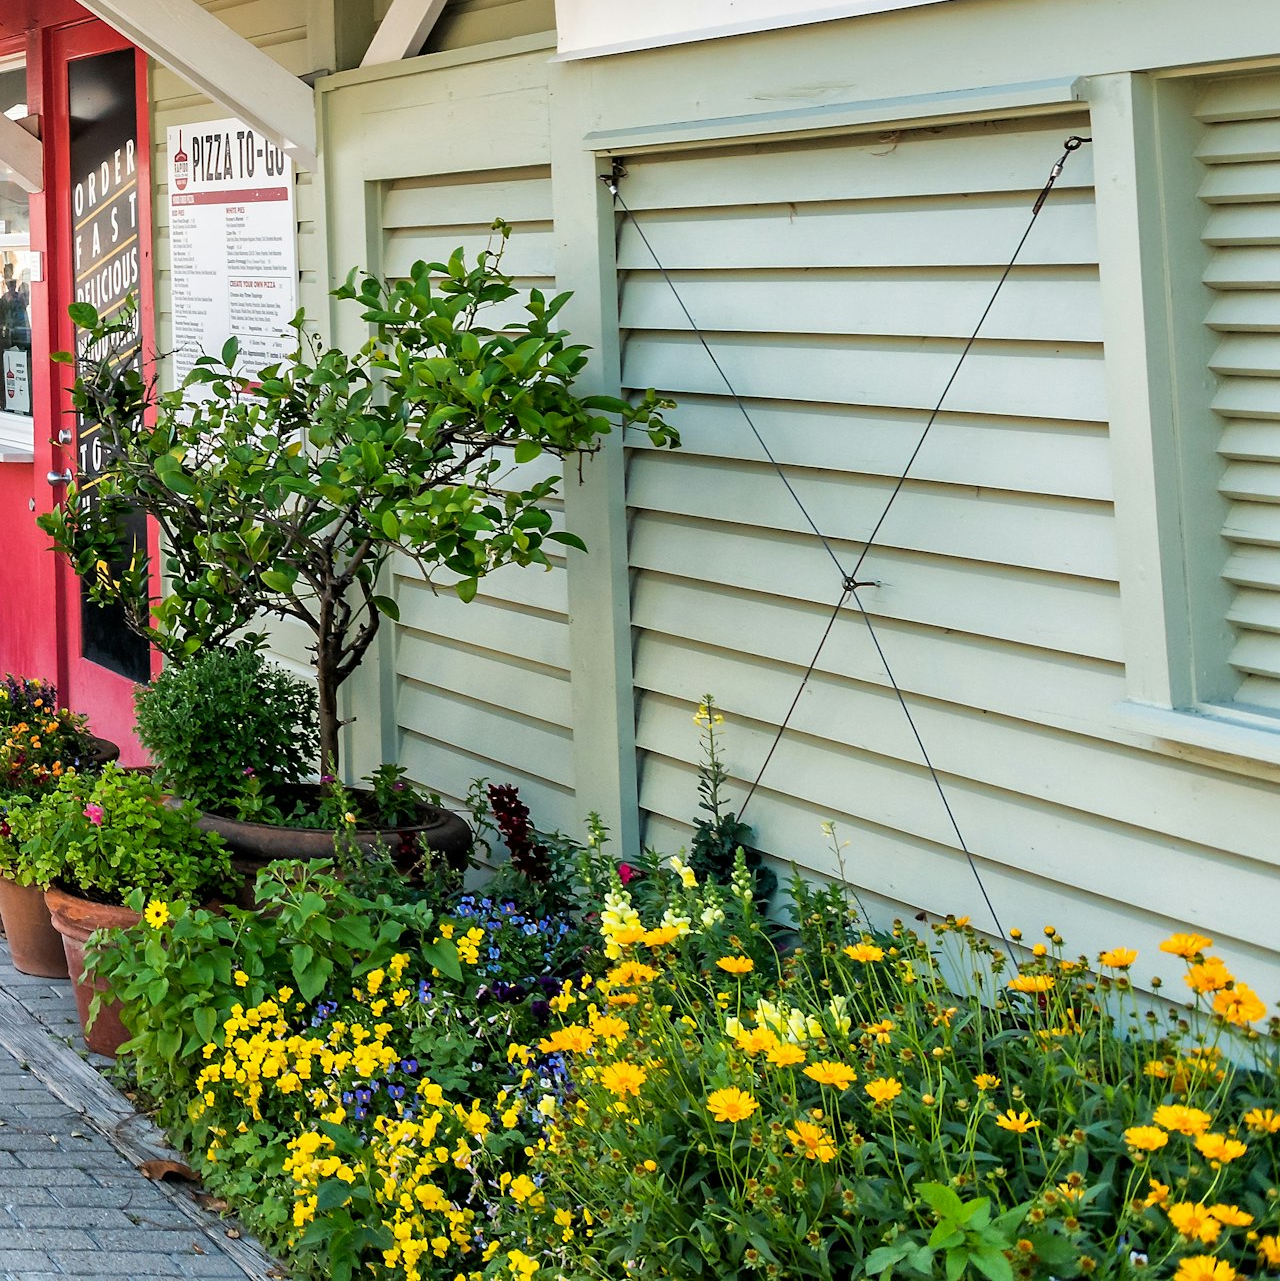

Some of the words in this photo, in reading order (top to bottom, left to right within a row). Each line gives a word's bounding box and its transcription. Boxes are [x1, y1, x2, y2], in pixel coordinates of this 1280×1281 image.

[75, 139, 135, 216] ORDER
[192, 132, 233, 182] PIZZA
[237, 130, 284, 178] TO-GO
[76, 191, 136, 270] FAST
[77, 247, 138, 309] DELICIOUS
